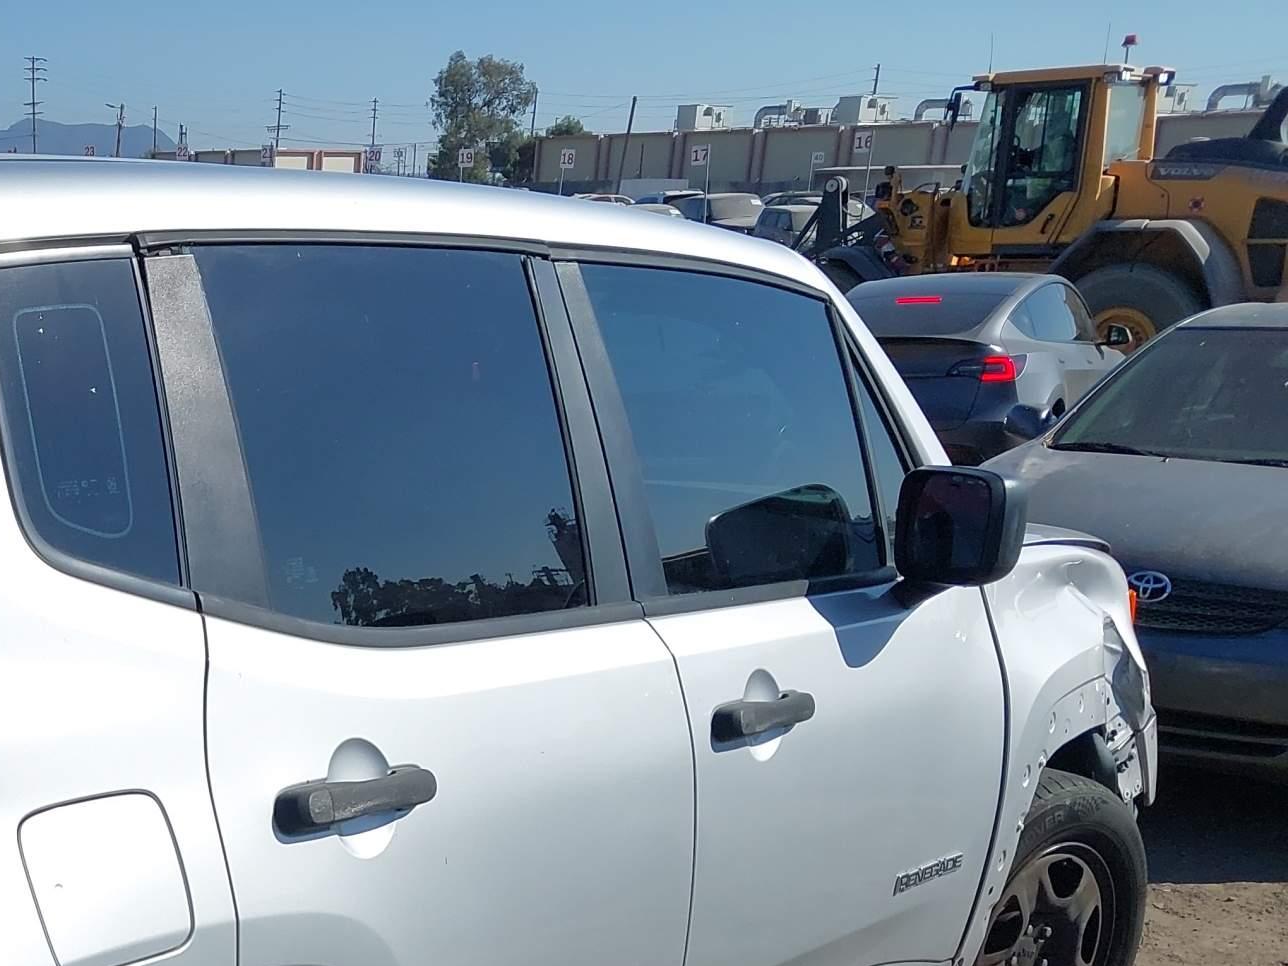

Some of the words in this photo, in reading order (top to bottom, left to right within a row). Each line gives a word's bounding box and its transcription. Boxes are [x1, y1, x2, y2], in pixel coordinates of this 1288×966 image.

[177, 146, 188, 157] 22
[368, 150, 381, 162] 20
[692, 148, 709, 162] 17
[460, 152, 473, 164] 19
[561, 152, 574, 165] 18
[892, 852, 964, 897] RENEGADE
